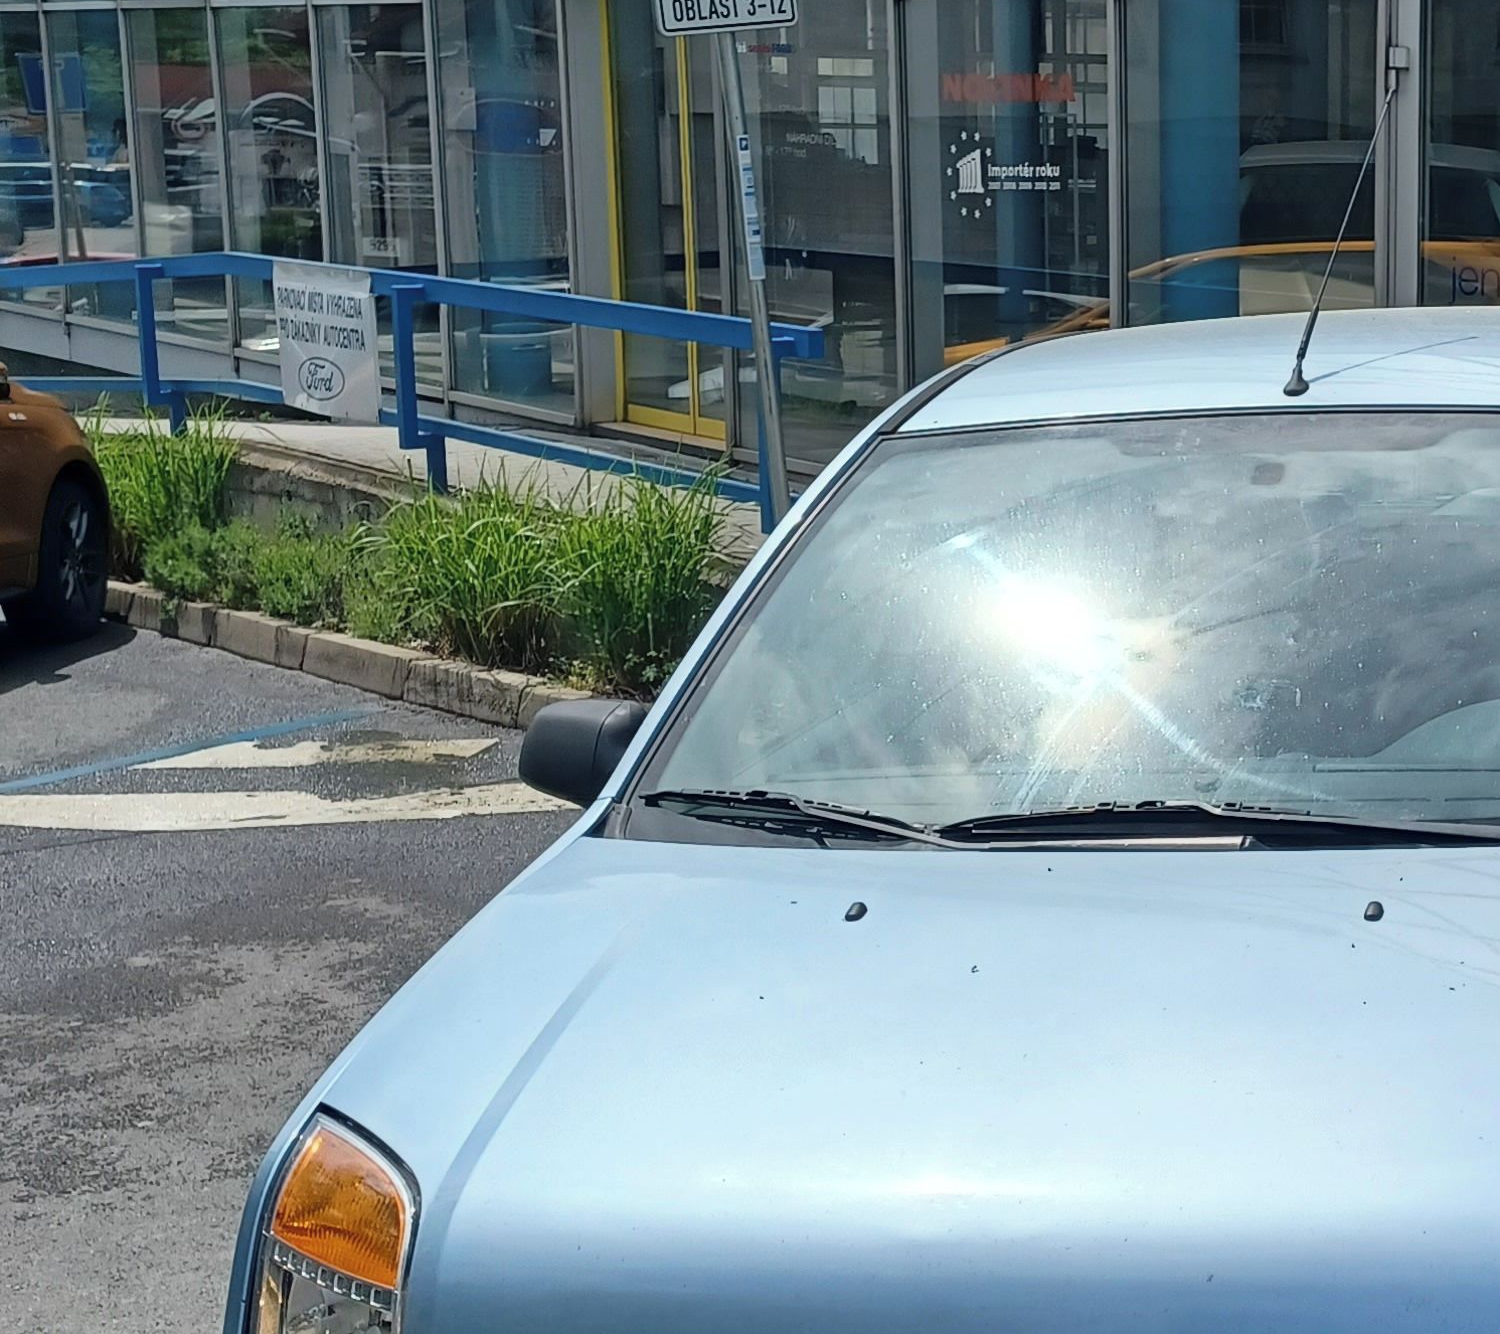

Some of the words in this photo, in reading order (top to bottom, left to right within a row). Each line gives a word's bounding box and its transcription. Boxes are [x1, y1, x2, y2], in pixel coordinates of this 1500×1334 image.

[987, 161, 1034, 179] Importér
[1035, 162, 1060, 177] roku
[306, 361, 334, 393] Ford
